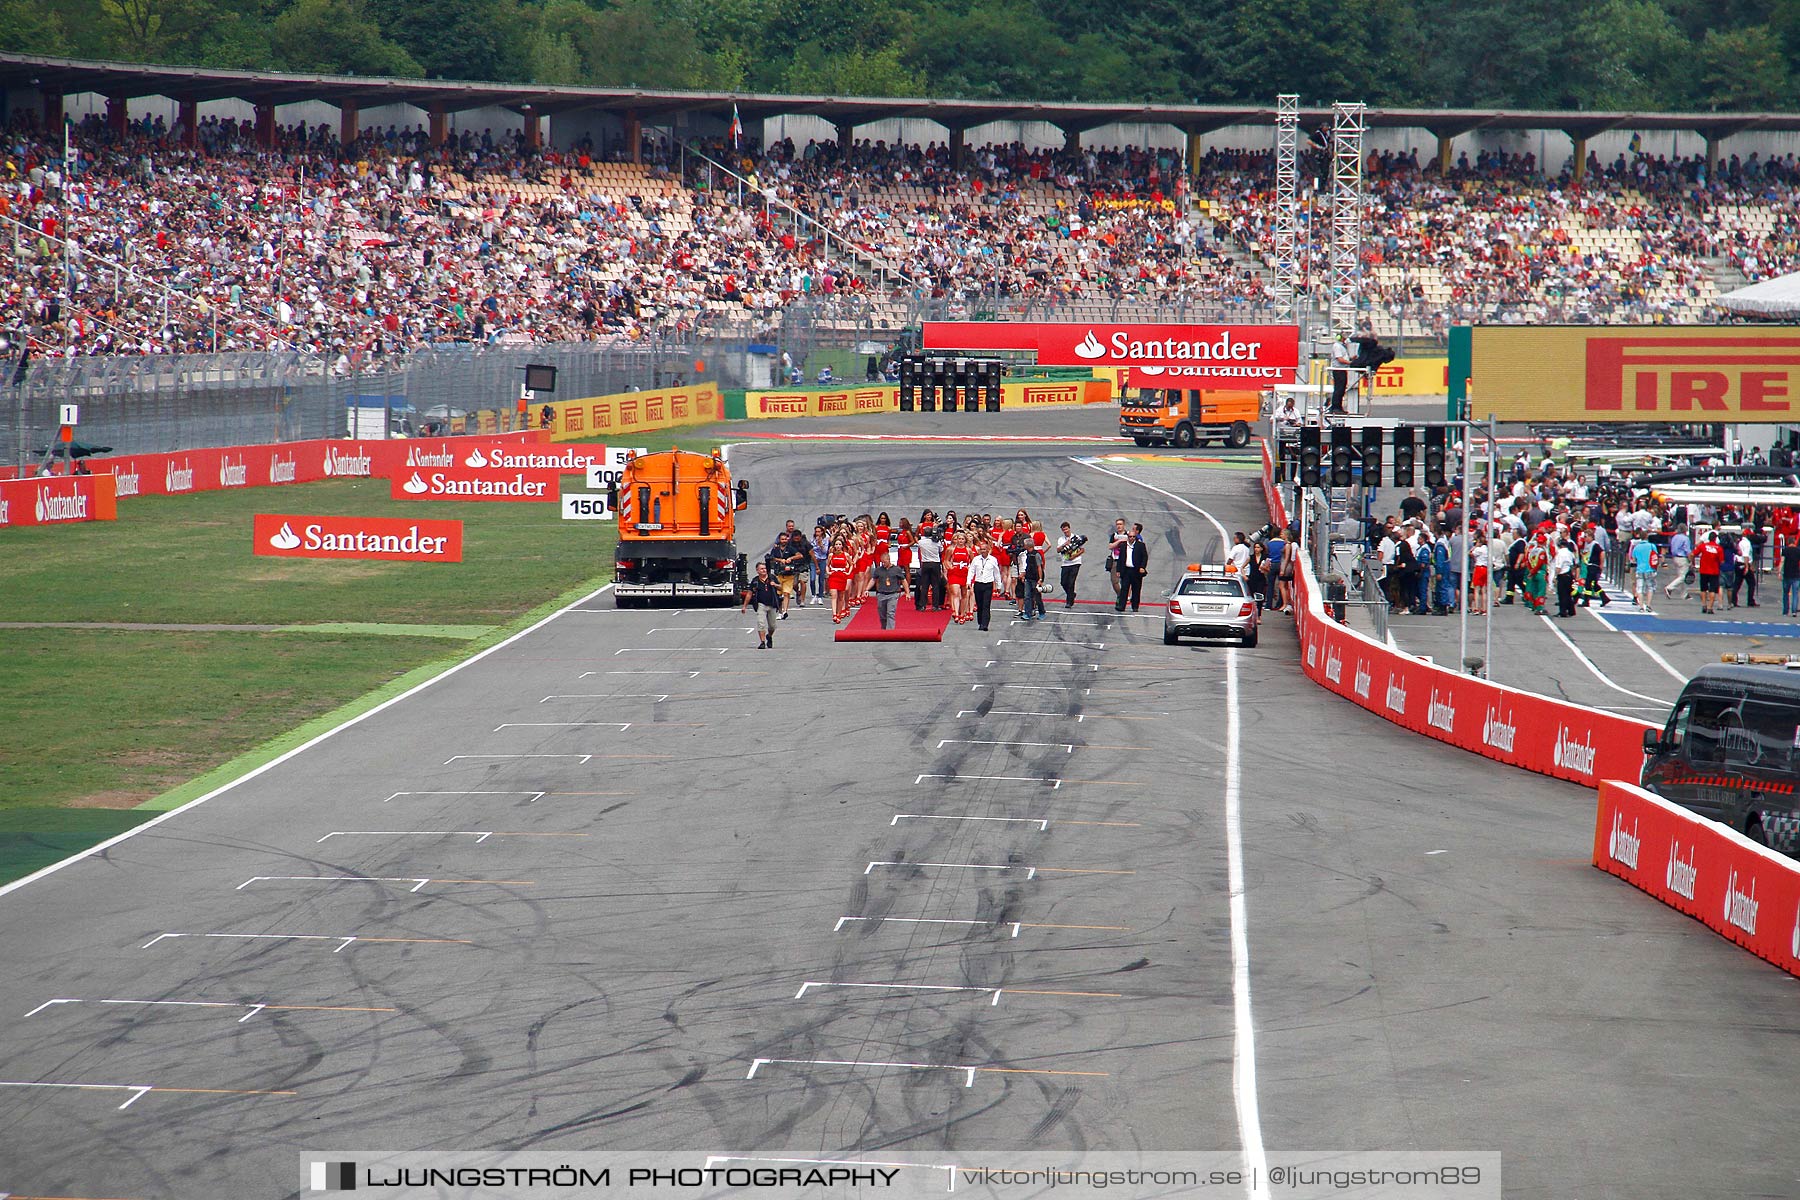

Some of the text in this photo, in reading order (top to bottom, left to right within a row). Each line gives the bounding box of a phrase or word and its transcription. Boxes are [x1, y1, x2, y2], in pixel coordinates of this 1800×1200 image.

[1111, 331, 1260, 361] Santander
[760, 396, 808, 413] PIRELLI
[818, 395, 847, 412] PIRELLI
[855, 392, 883, 409] PIRELLI
[1024, 386, 1077, 403] PIRELLI
[66, 407, 70, 422] 1
[593, 404, 611, 429] PIRELLI
[620, 401, 638, 425] PIRELLI
[646, 397, 664, 421] PIRELLI
[275, 451, 295, 482] Santander
[332, 445, 372, 476] Santander
[415, 443, 454, 468] Santander
[490, 449, 595, 468] Santander
[225, 453, 246, 485] Santander
[431, 473, 547, 497] Santander
[44, 481, 87, 521] Santander
[570, 500, 604, 514] 150
[304, 524, 448, 554] Santander
[1488, 706, 1516, 753] Santander
[1561, 726, 1596, 776] Santander
[1615, 812, 1641, 870] Santander
[1671, 841, 1697, 900] Santander
[1730, 870, 1758, 935] Santander
